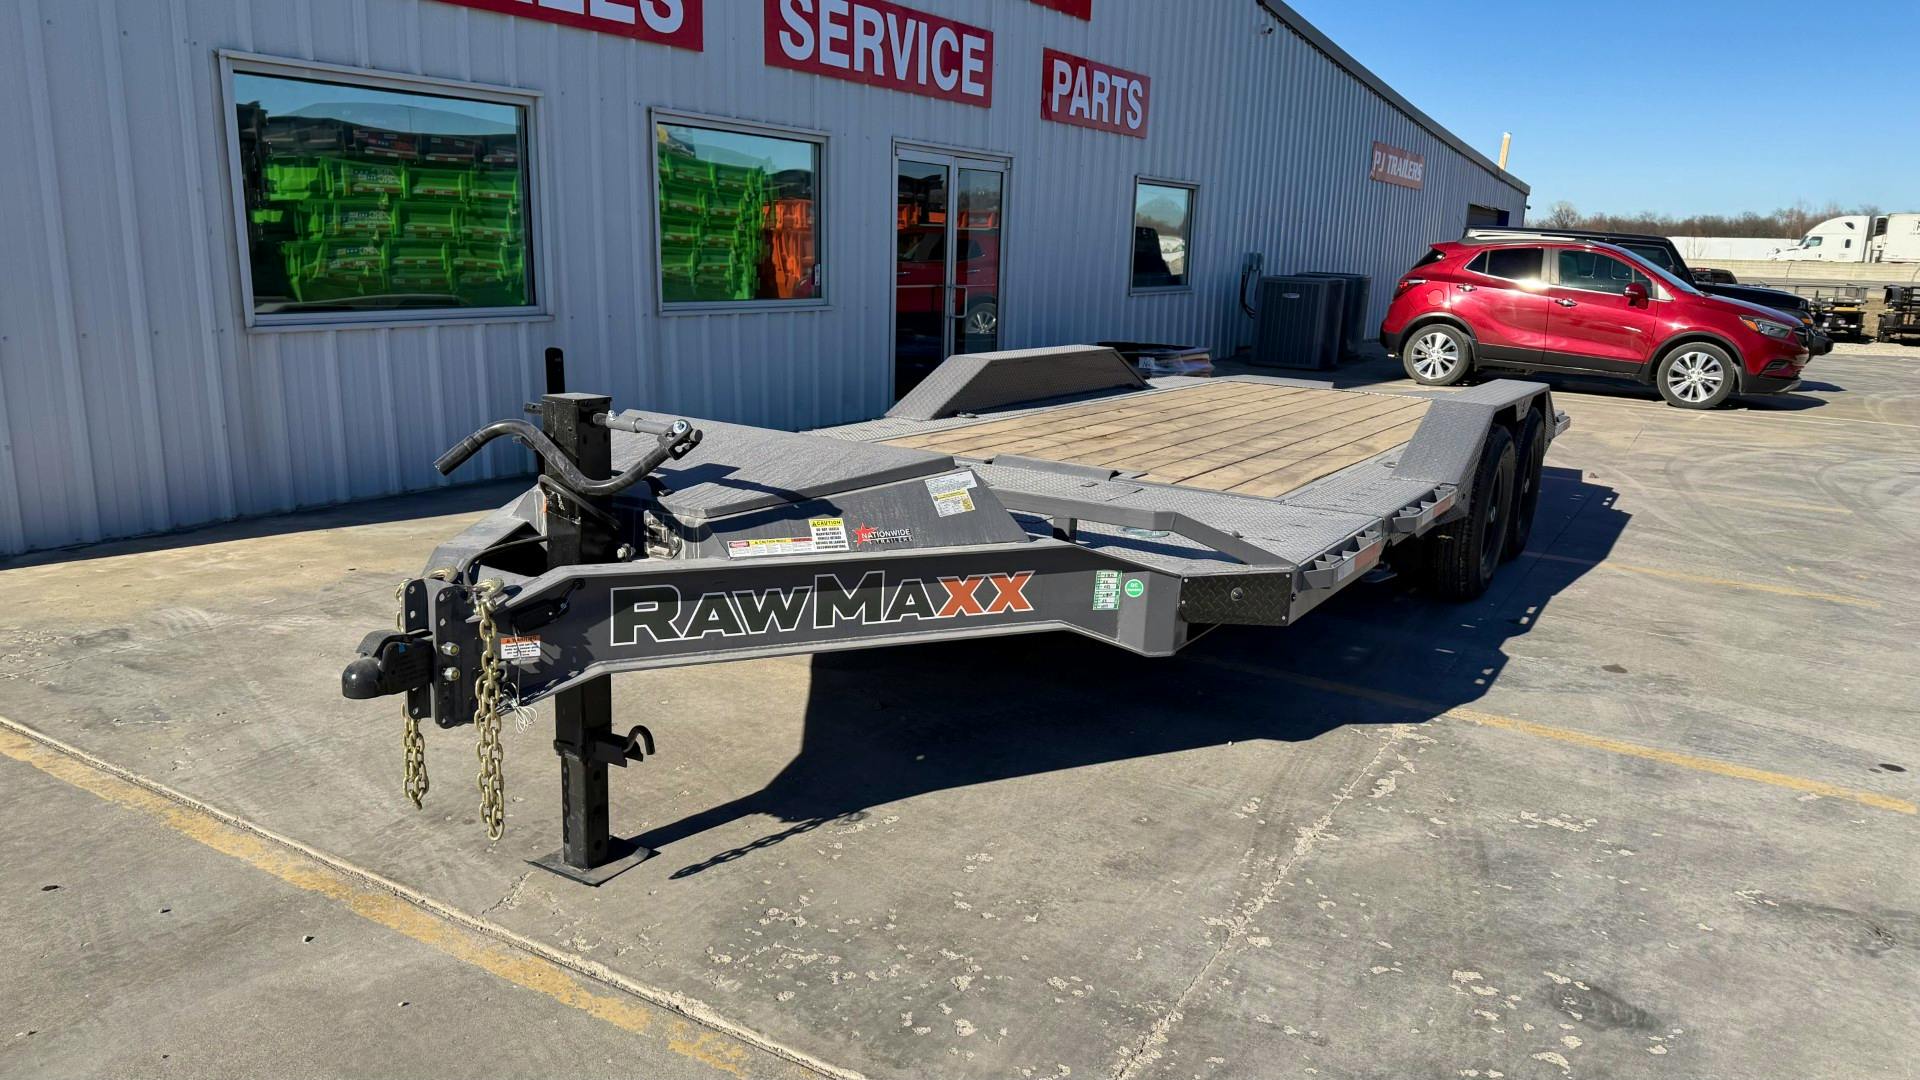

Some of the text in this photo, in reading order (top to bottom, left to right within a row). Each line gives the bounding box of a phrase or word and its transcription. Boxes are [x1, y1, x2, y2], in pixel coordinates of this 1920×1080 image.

[779, 0, 985, 97] SERVICE
[1052, 59, 1143, 129] PARTS
[1373, 150, 1423, 181] PJ TRAILERS
[862, 528, 911, 539] NATIONWIDE
